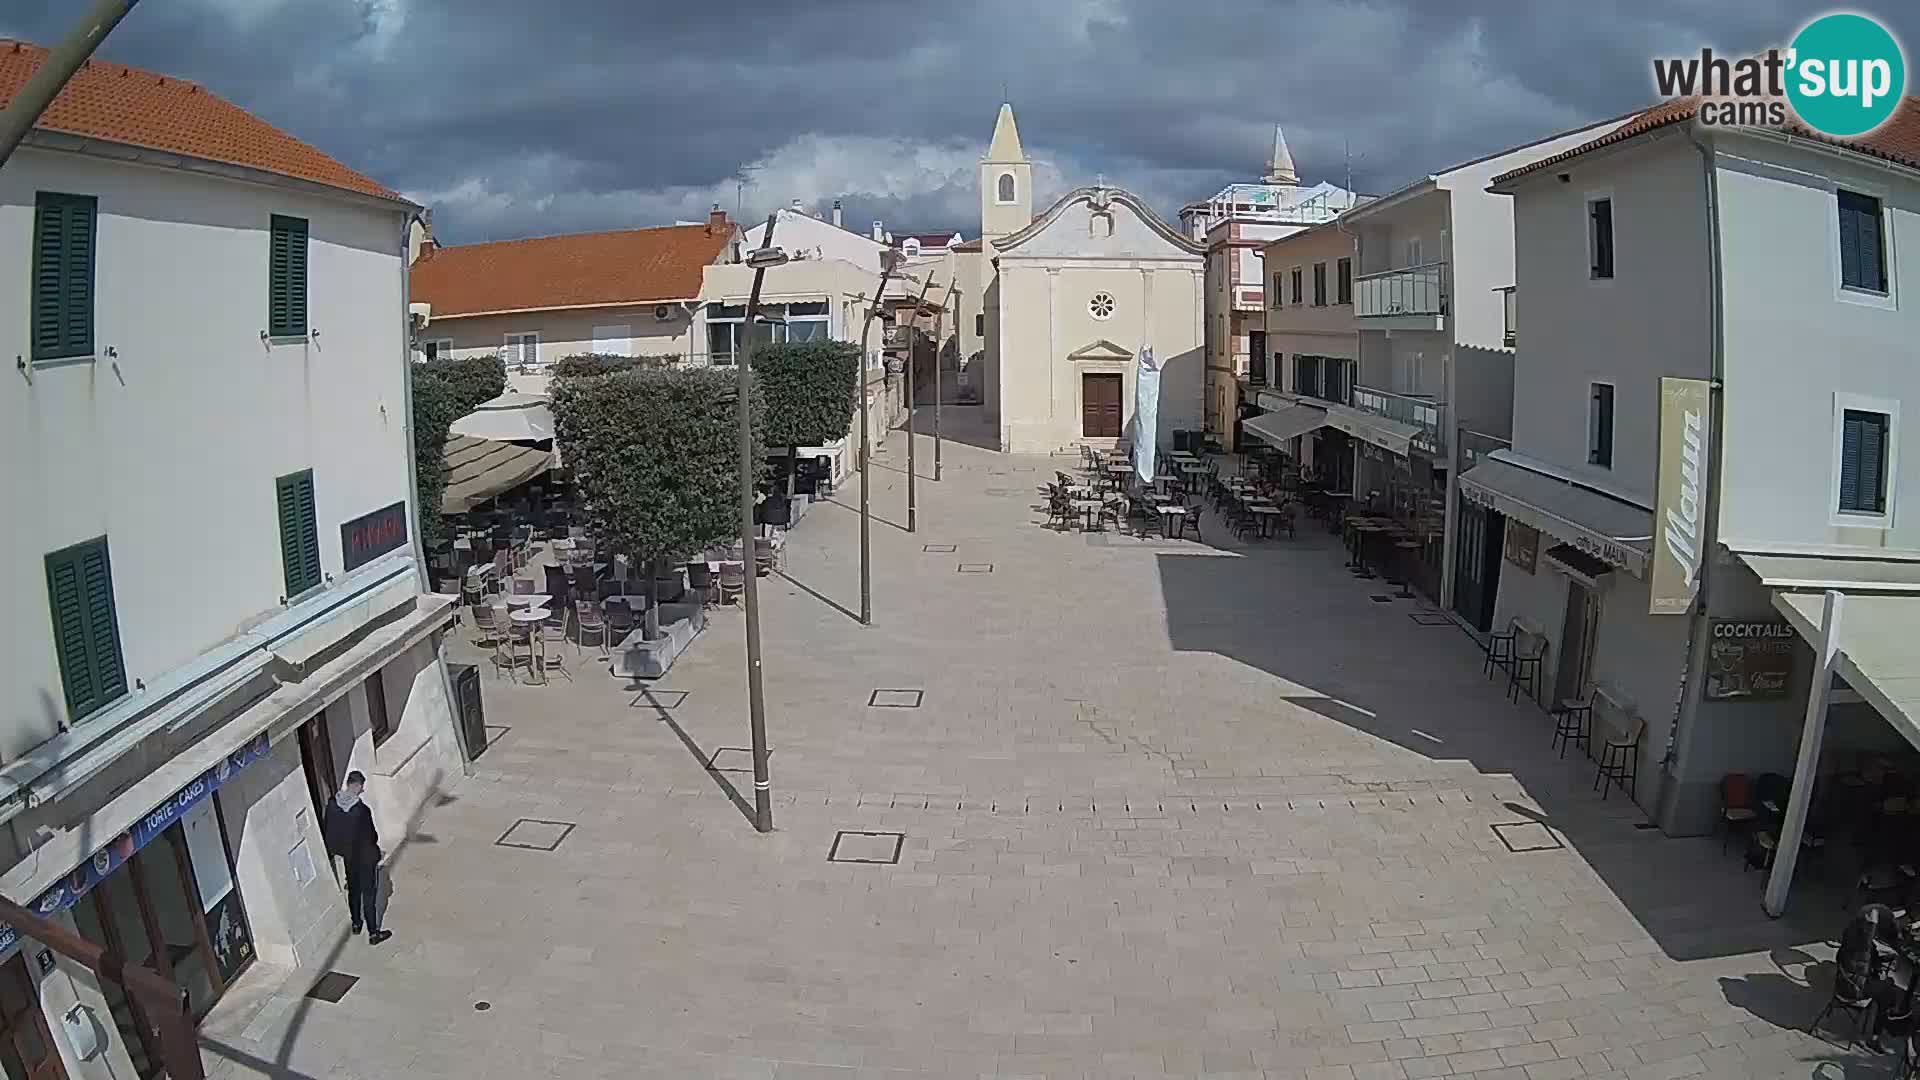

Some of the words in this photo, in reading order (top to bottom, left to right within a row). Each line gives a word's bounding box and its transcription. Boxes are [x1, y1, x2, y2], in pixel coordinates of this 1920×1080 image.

[1714, 622, 1794, 638] COCKTAILS
[144, 802, 174, 832] TORTE
[178, 780, 205, 806] CAKES
